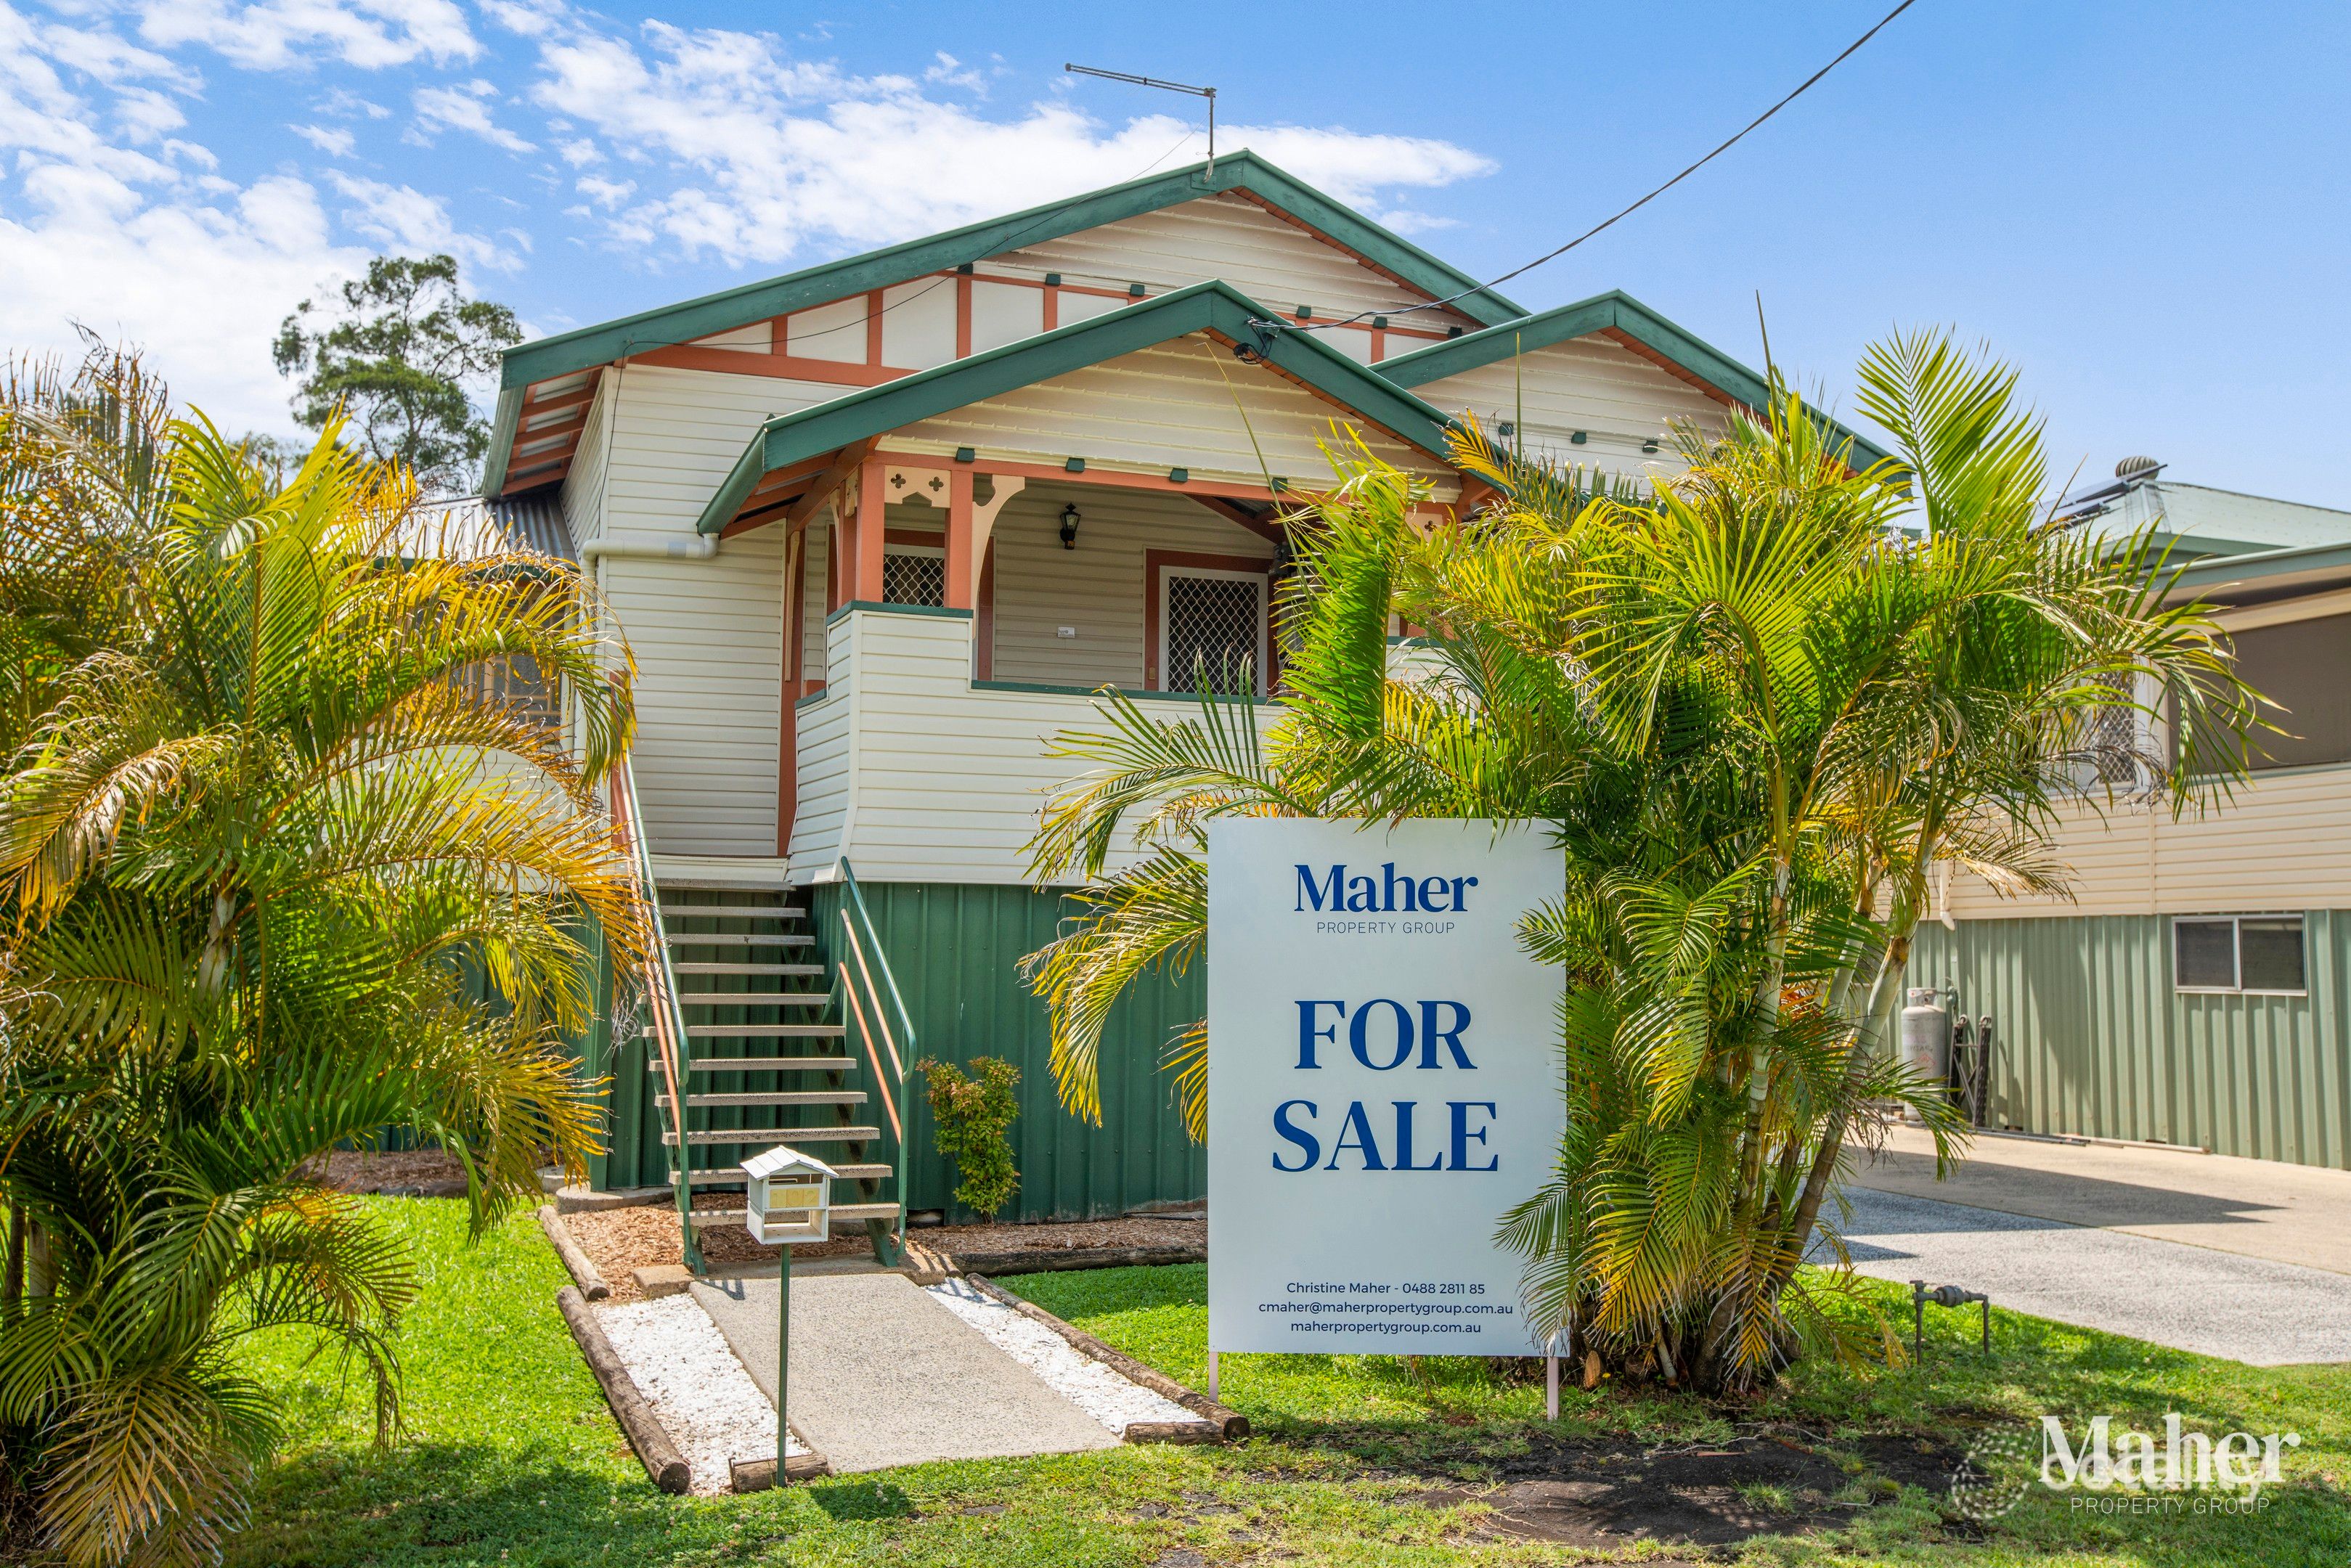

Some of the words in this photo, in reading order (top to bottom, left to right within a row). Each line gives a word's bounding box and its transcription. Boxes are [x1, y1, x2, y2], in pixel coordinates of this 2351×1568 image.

[1294, 862, 1479, 913] Maher
[1316, 921, 1397, 934] PROPERTY
[1402, 921, 1455, 934] GROUP
[1294, 998, 1478, 1071] FOR
[1272, 1099, 1499, 1173] SALE
[773, 1190, 818, 1207] 102
[1287, 1281, 1345, 1294] Christine
[1349, 1282, 1391, 1294] Maher
[1402, 1283, 1436, 1294] 0488
[1258, 1301, 1513, 1316] cmaher@maherpropertygroup.com.au
[1291, 1320, 1481, 1335] maherpropertygroup.com.au
